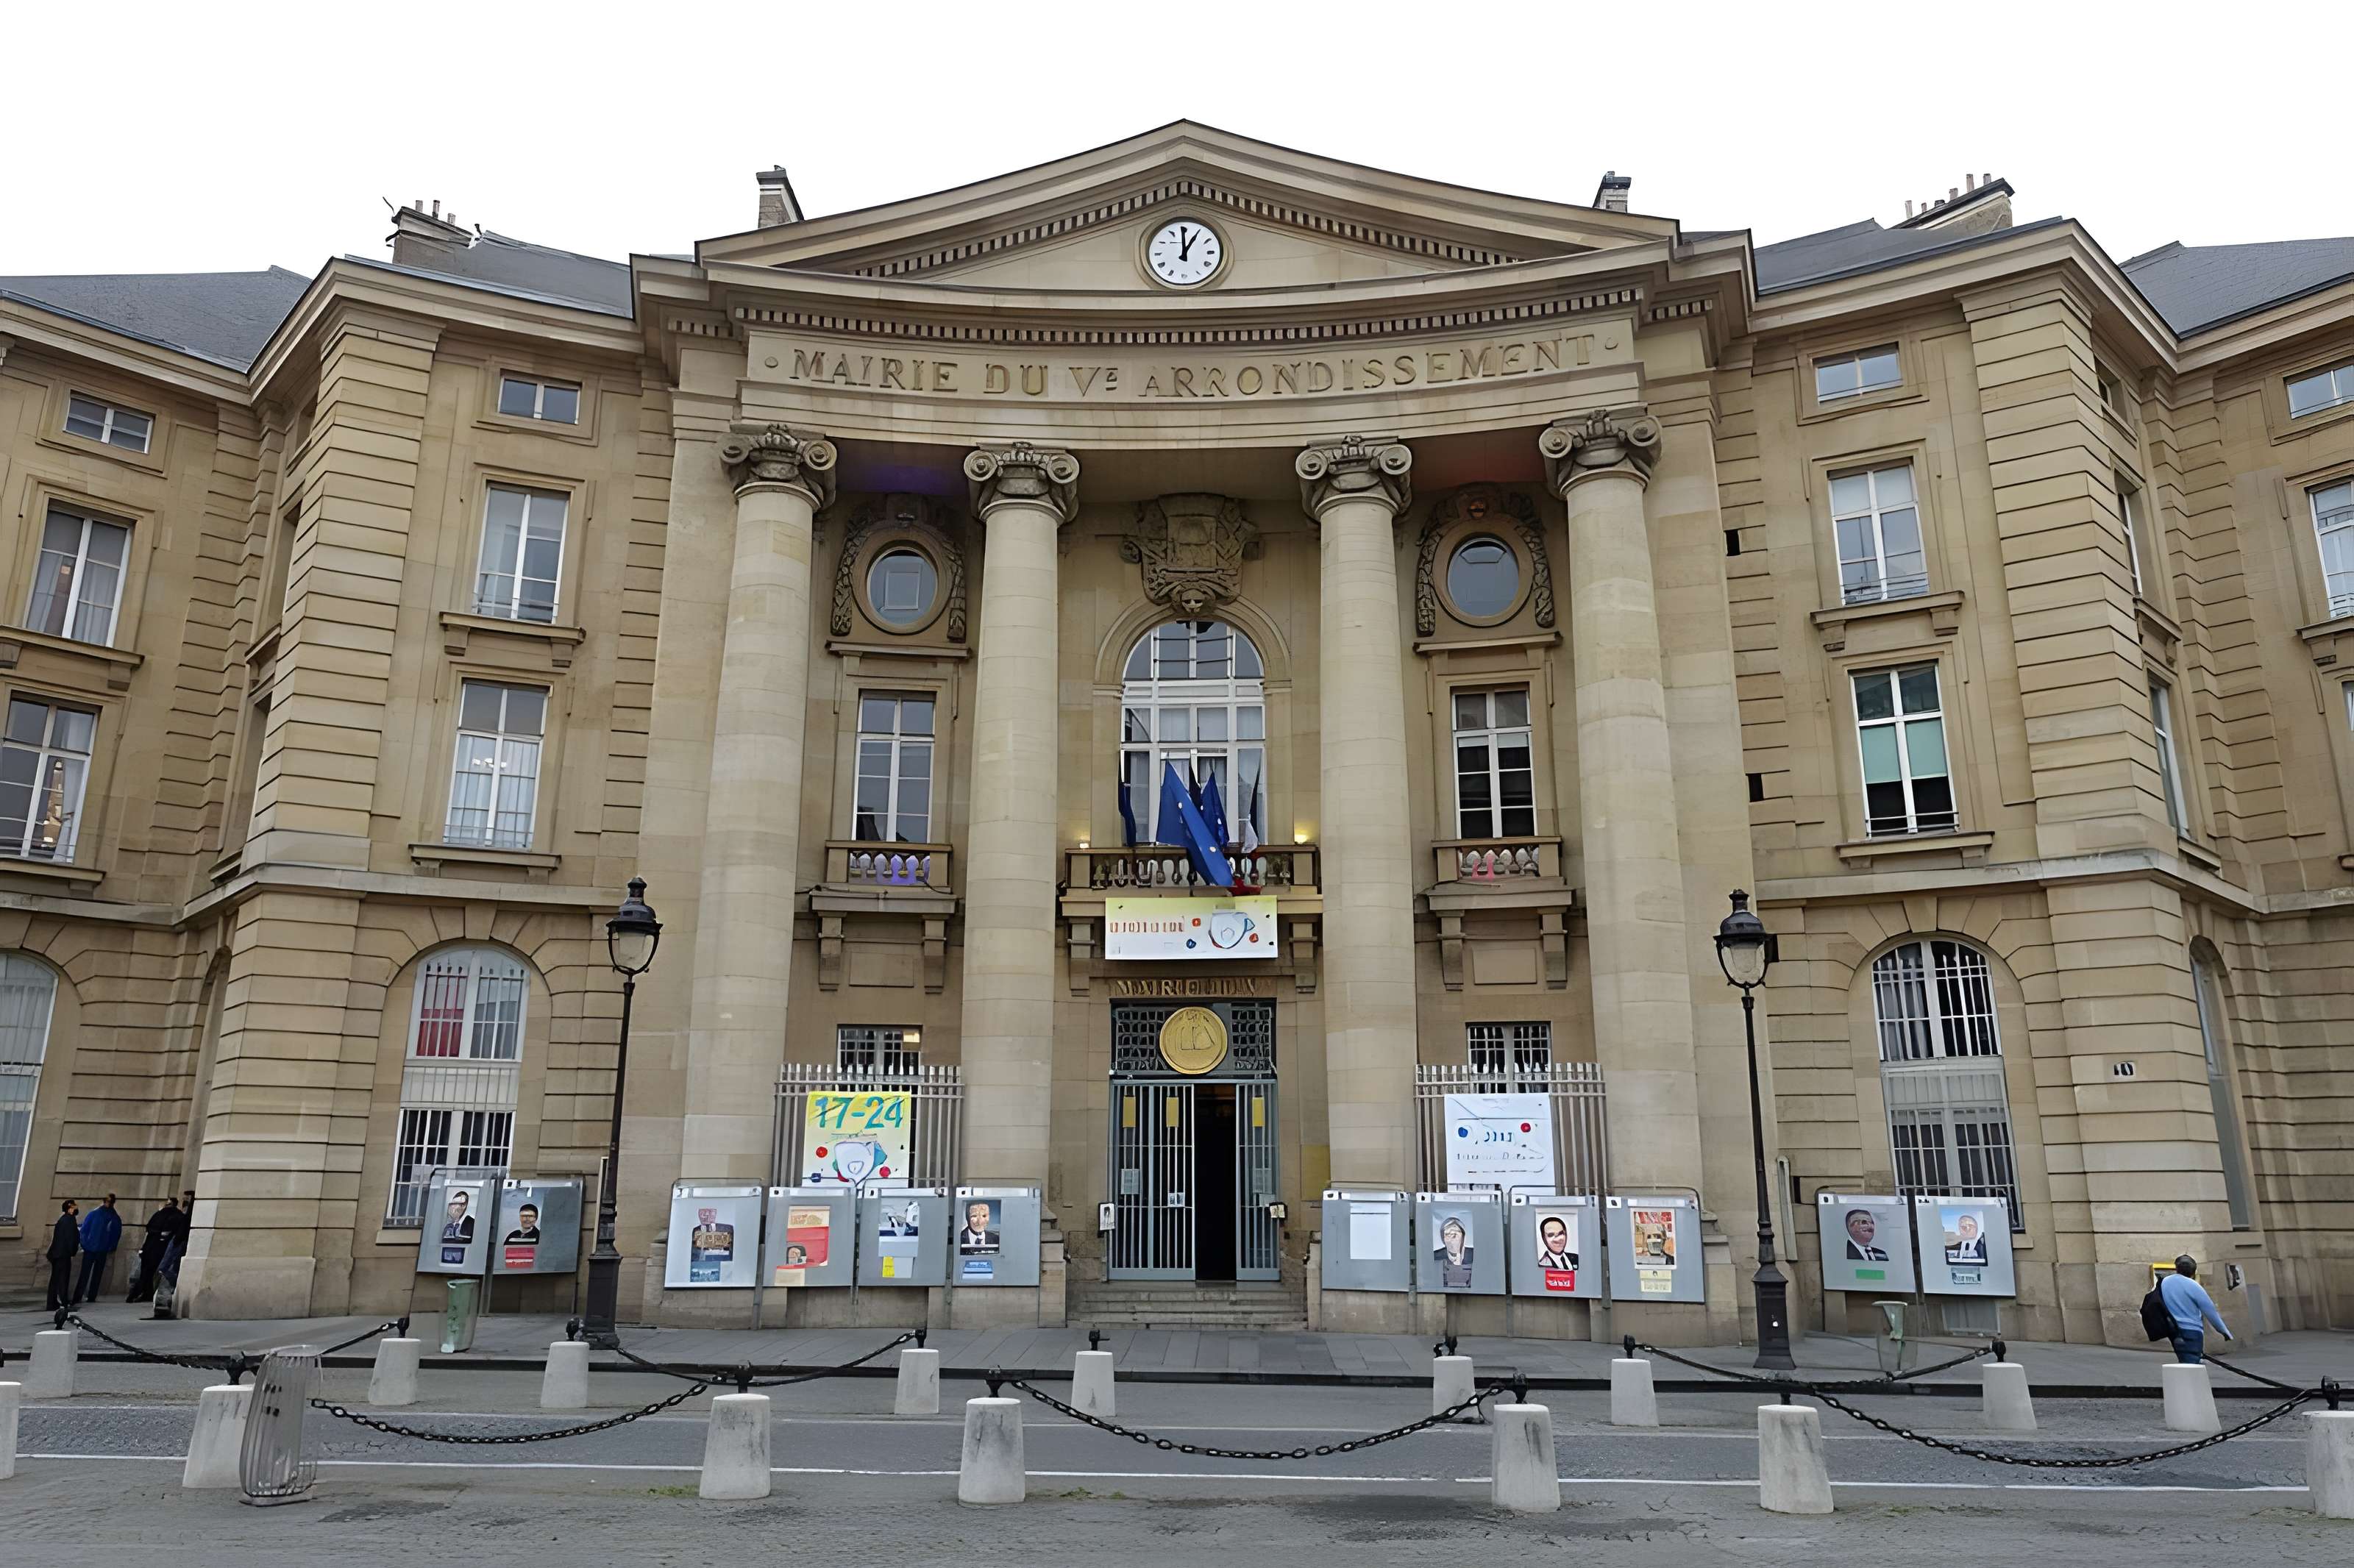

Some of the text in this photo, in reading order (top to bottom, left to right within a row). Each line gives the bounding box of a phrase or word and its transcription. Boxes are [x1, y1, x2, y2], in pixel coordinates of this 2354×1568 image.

[789, 349, 958, 392] MAIRIE
[984, 363, 1048, 396] DU
[1138, 333, 1595, 397] ARRONDISSEMENT
[814, 1095, 906, 1129] 17-24
